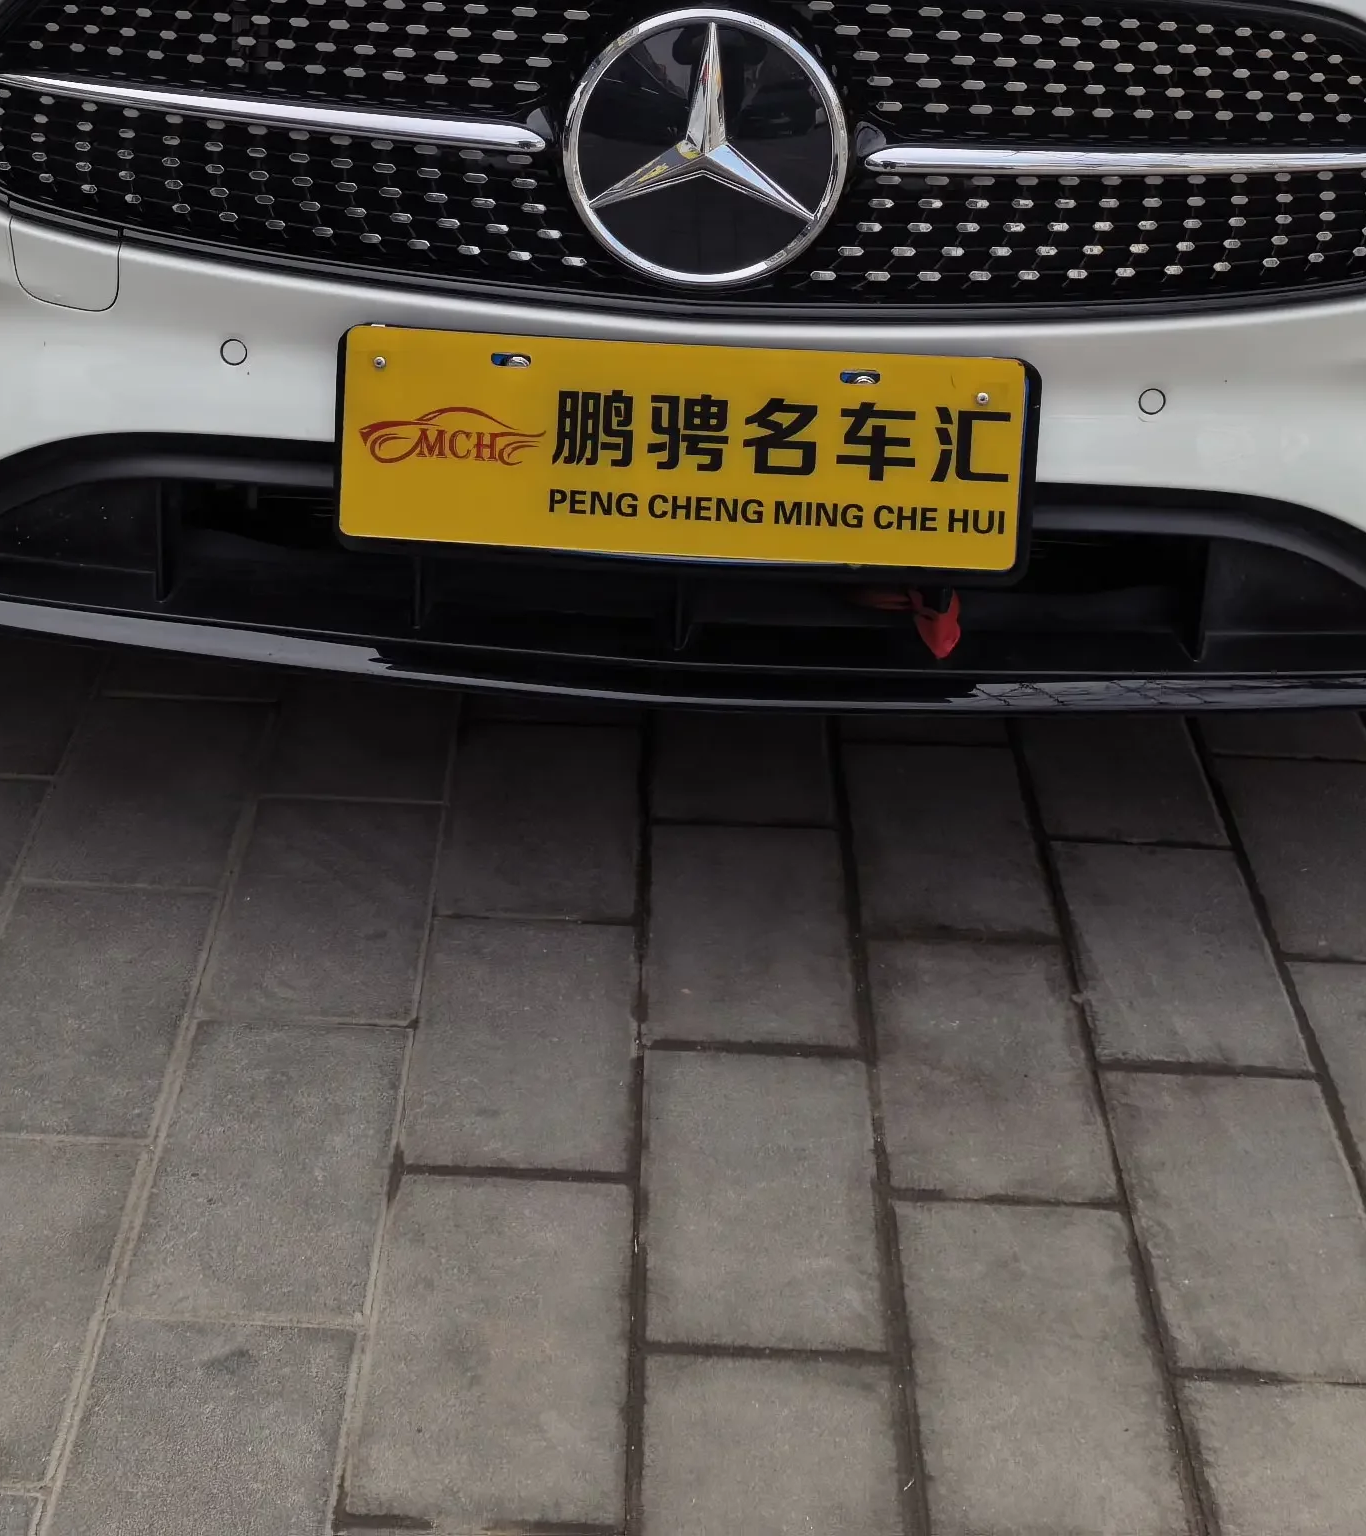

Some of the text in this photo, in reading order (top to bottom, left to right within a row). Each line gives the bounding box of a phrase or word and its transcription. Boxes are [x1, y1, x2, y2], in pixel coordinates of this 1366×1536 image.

[551, 389, 1012, 483] 鹏骋名车汇
[548, 488, 1006, 535] PENG CHENG MING CHE HUI
